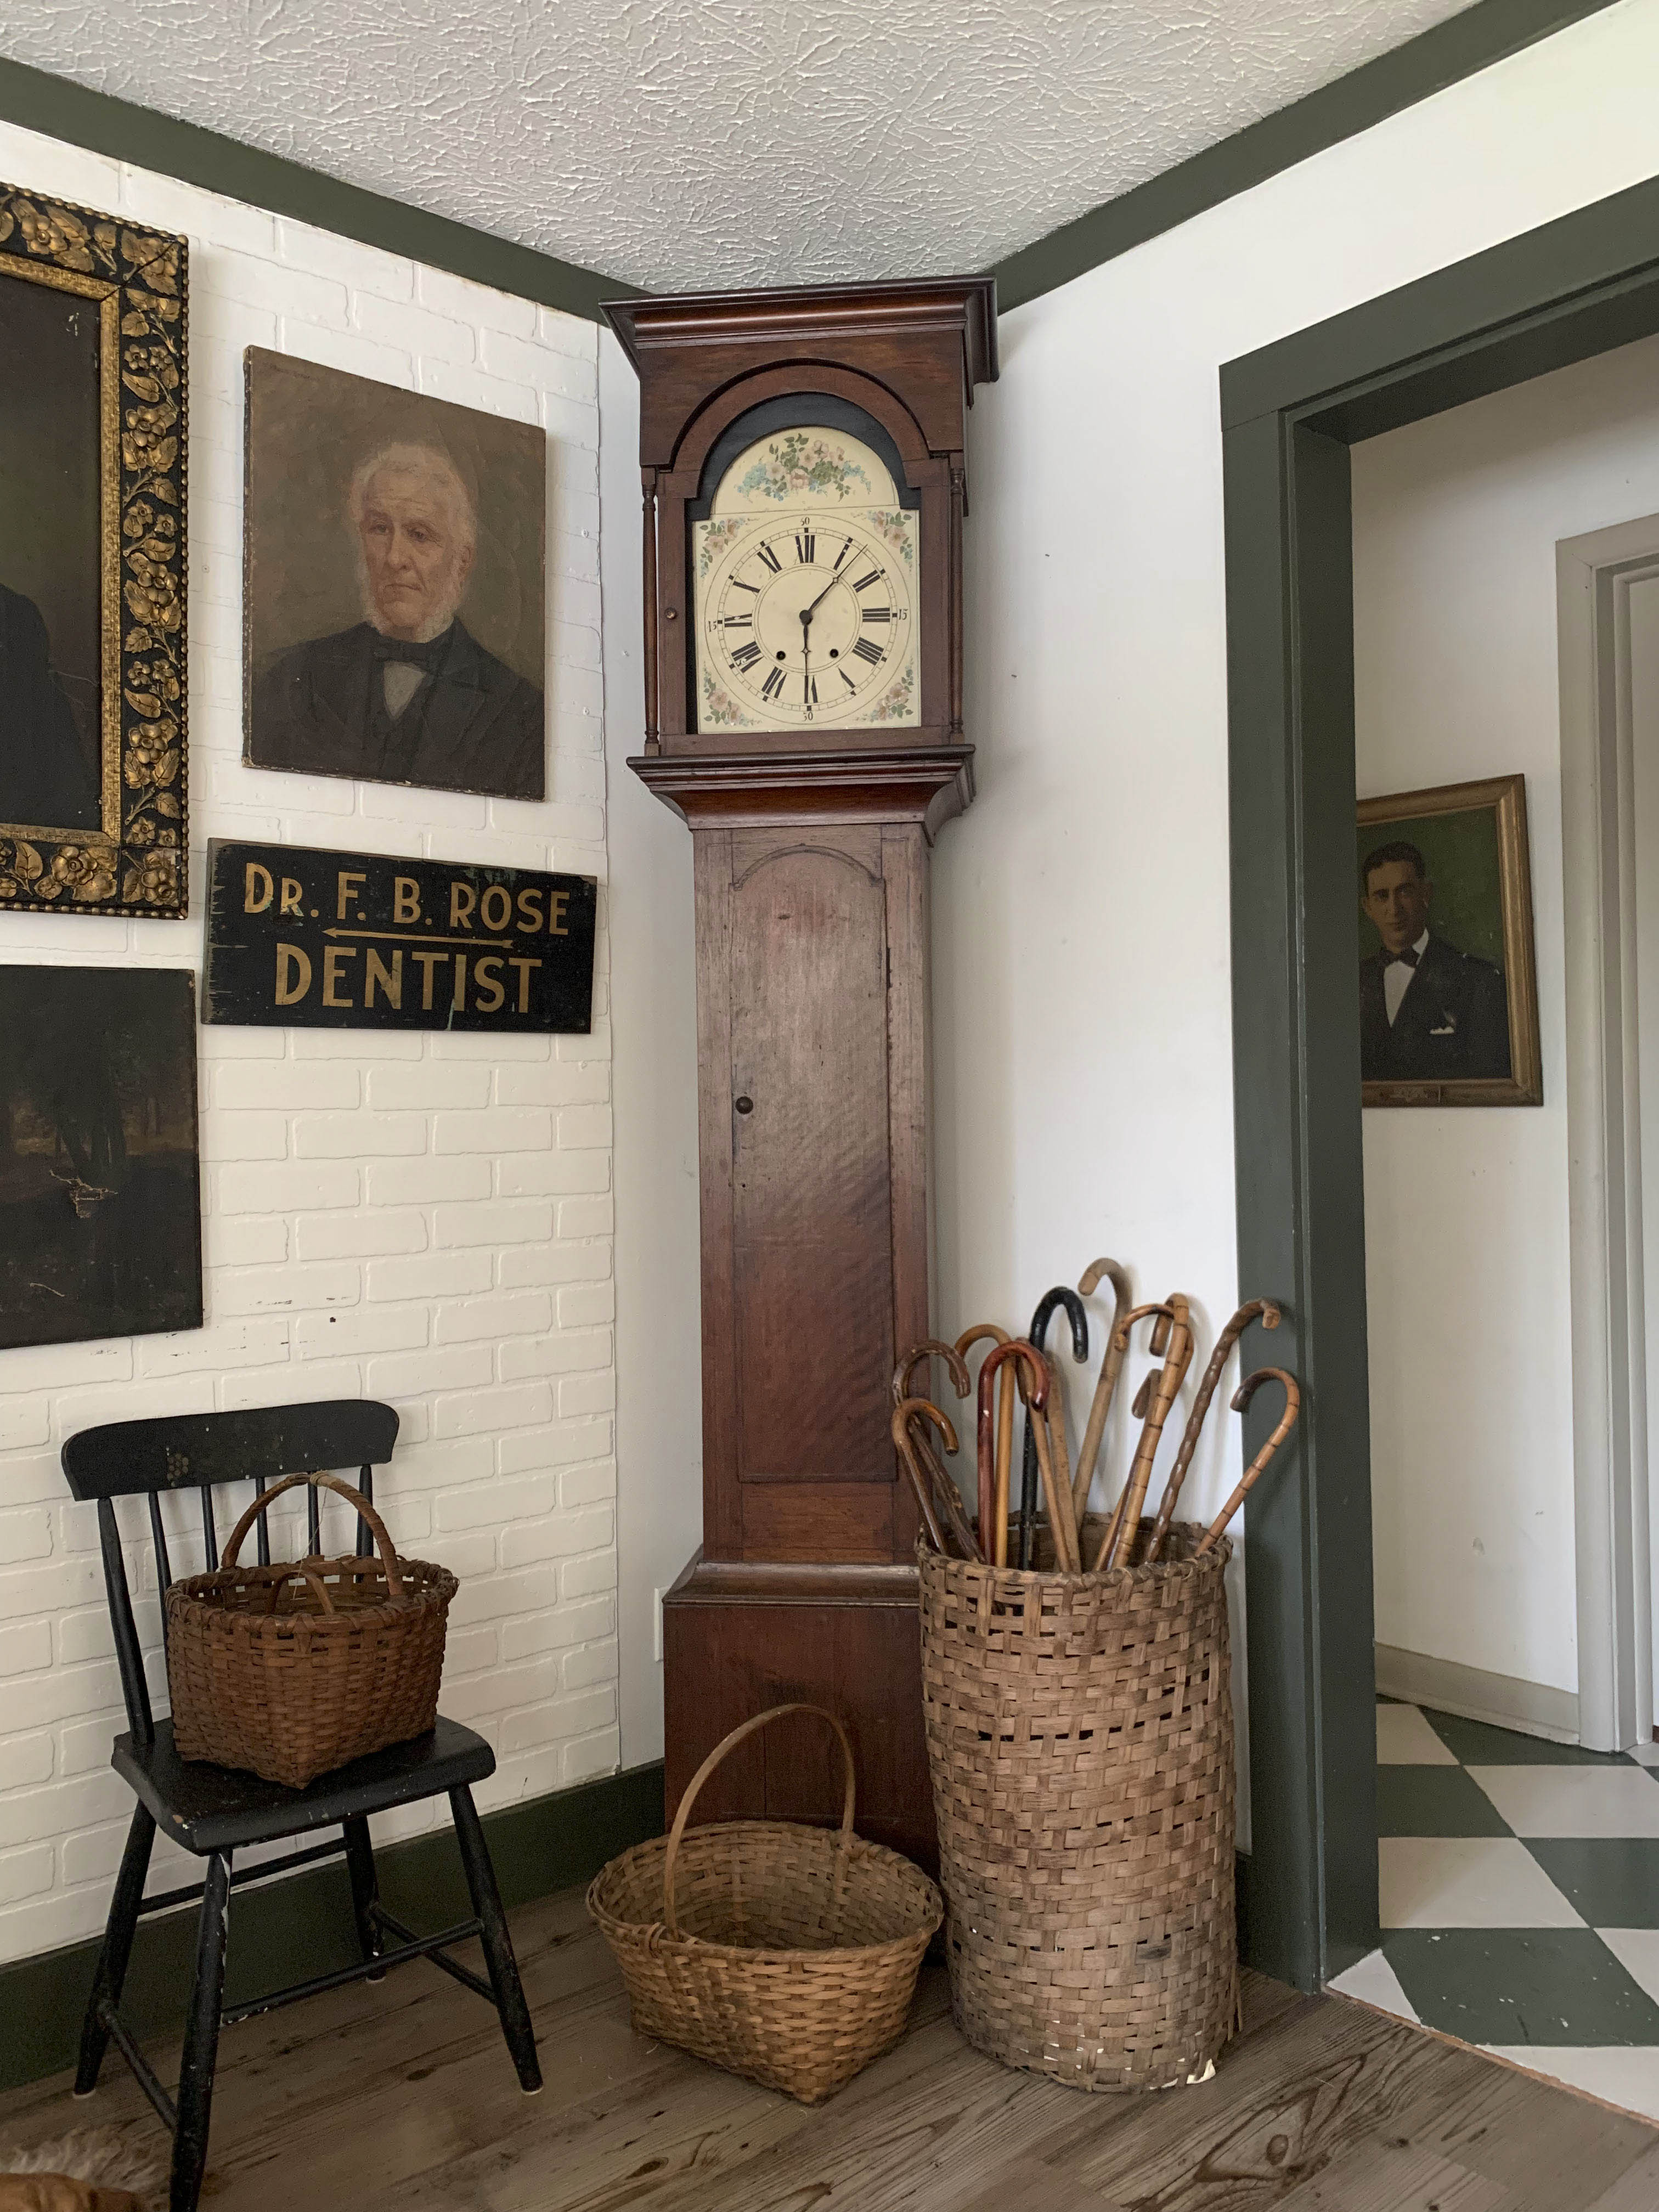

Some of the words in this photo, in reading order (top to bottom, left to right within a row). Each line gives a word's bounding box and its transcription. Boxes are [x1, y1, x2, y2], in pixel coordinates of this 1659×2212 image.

[757, 545, 782, 578] XI
[794, 534, 816, 564] XII
[833, 544, 850, 571] I
[732, 575, 761, 597] X
[852, 569, 881, 593] II
[724, 613, 752, 628] IX
[862, 607, 890, 623] III
[899, 609, 908, 620] 15
[731, 641, 765, 674] VIII
[851, 636, 884, 666] IIII
[761, 665, 788, 699] VII
[837, 667, 856, 692] V
[244, 862, 319, 918] DR.
[337, 871, 366, 921] F.
[393, 877, 432, 926] B.
[450, 882, 570, 935] ROSE
[275, 943, 543, 1014] DENTIST
